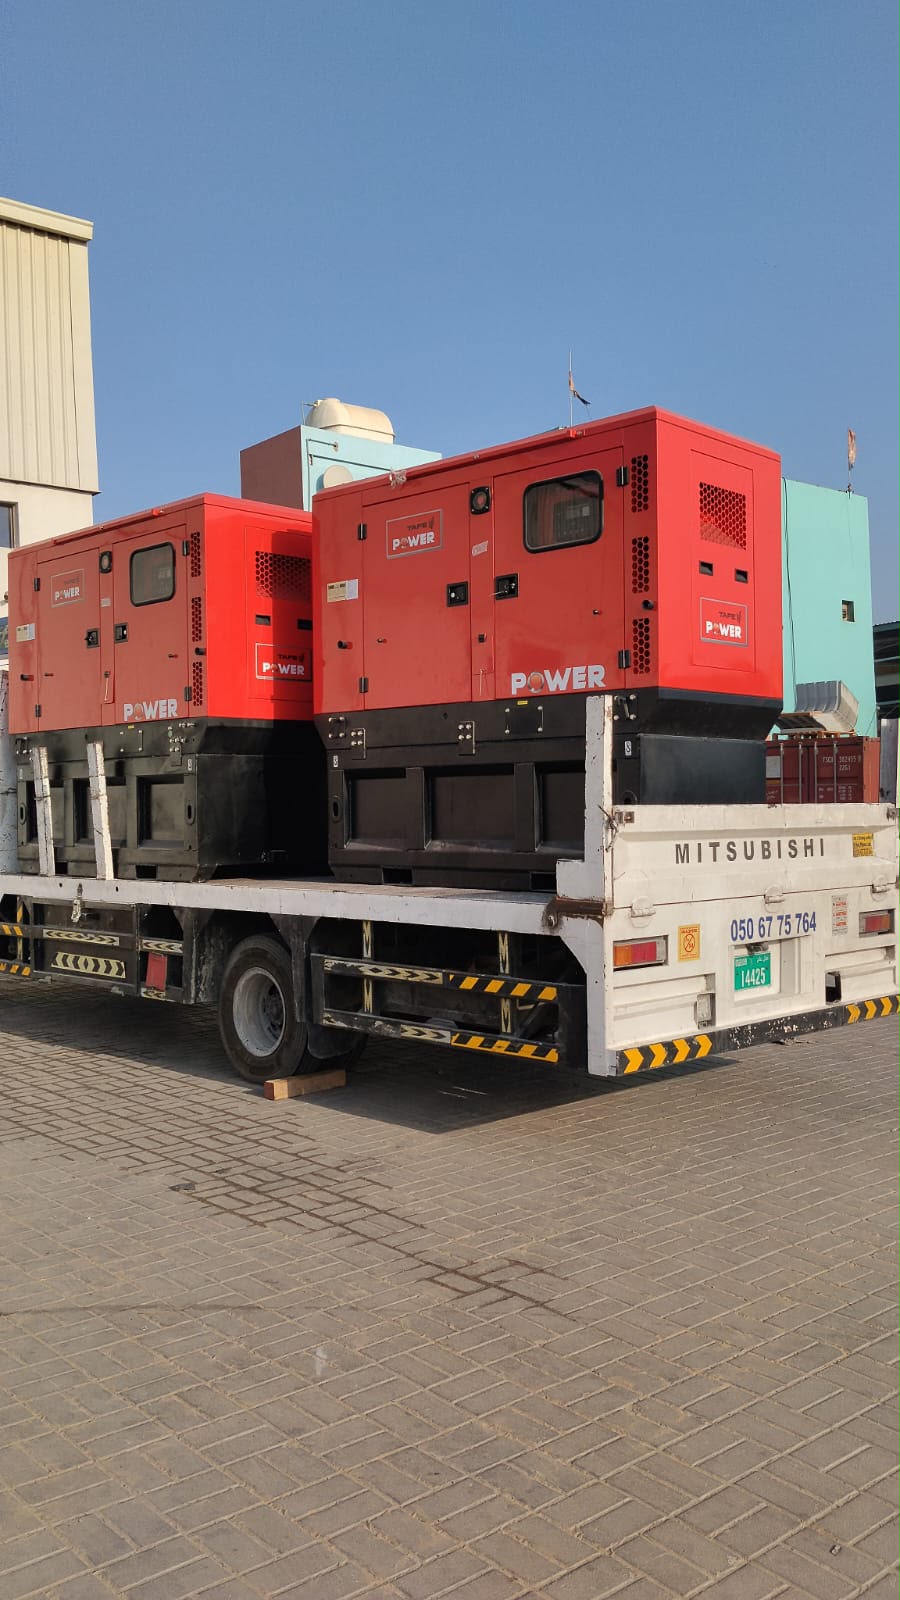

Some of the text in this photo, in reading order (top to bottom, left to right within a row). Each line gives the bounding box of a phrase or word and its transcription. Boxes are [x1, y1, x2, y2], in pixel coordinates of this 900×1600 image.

[393, 532, 435, 550] POWER
[55, 587, 80, 600] POWER
[706, 621, 742, 639] POWER
[262, 662, 305, 675] POWER
[511, 665, 606, 695] POWER
[123, 699, 178, 721] POWER
[675, 838, 824, 864] MITSUBISHI
[730, 918, 754, 941] 050
[758, 916, 773, 938] 67
[776, 914, 791, 935] 75
[795, 911, 816, 934] 764
[741, 967, 766, 988] 14425
